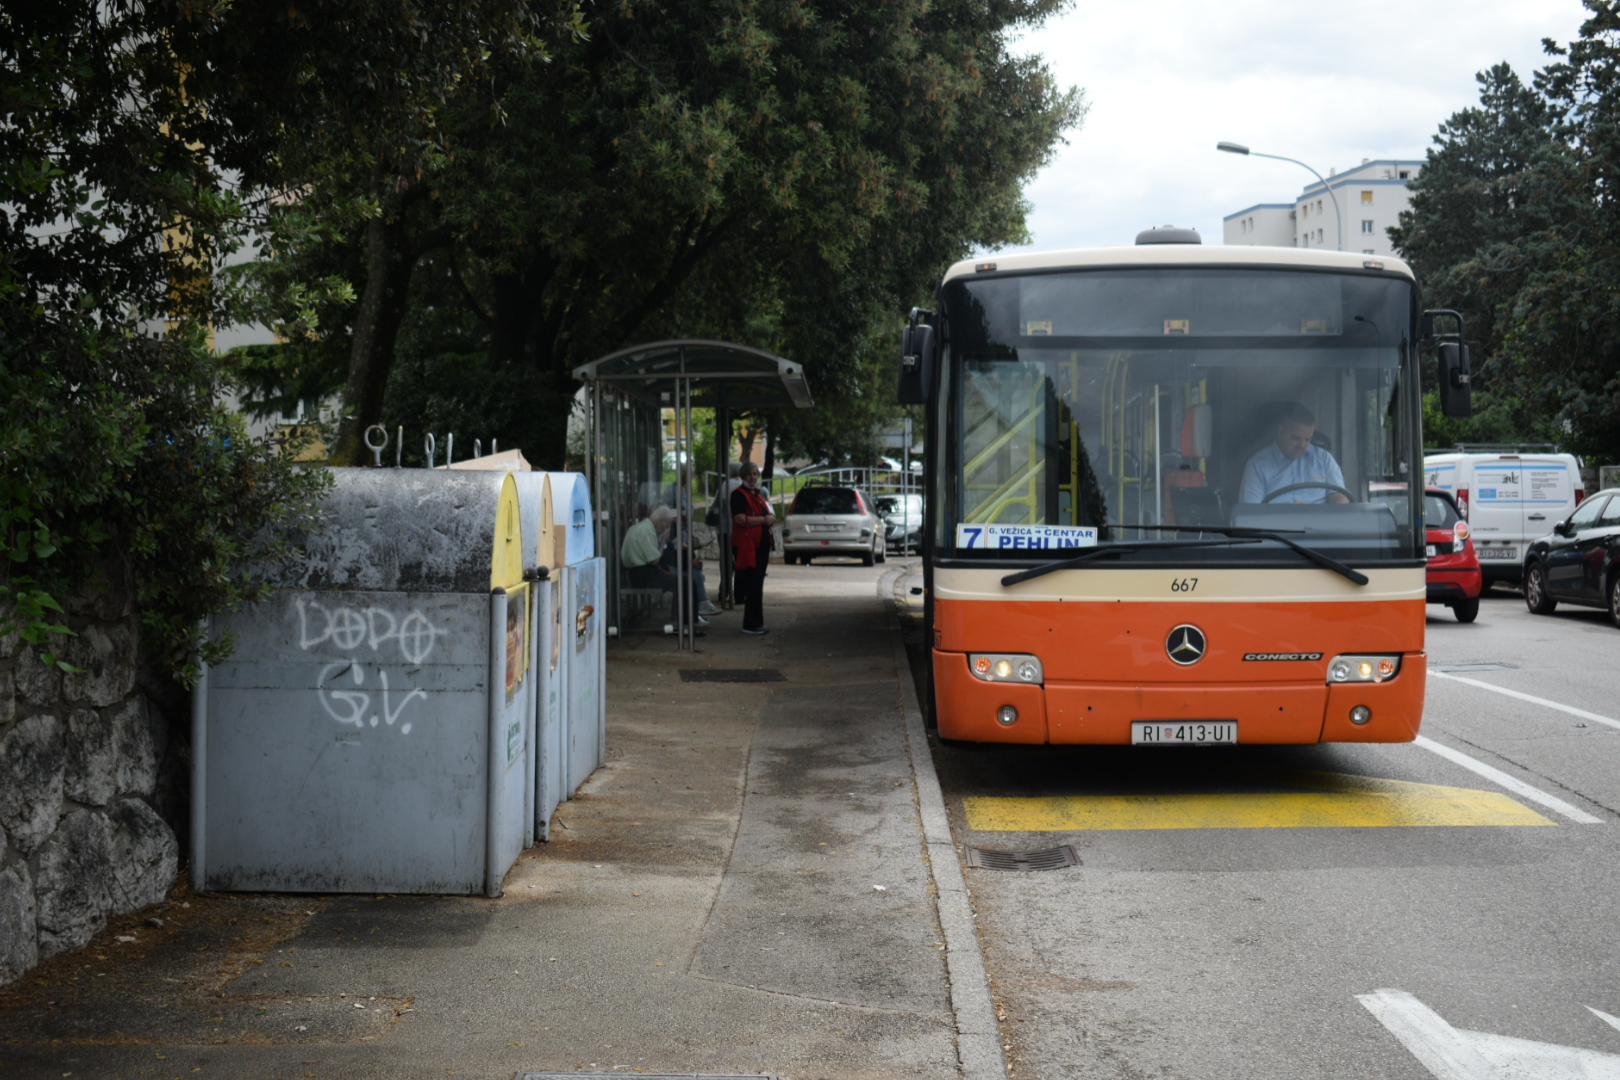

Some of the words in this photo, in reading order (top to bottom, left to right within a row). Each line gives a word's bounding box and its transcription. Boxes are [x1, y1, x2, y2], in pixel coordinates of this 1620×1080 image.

[963, 528, 982, 549] 7
[989, 527, 998, 535] G.
[1000, 526, 1032, 536] VEŽICA
[1044, 528, 1093, 538] CENTAR
[1171, 578, 1198, 592] 667
[1244, 653, 1320, 661] CONECTO
[1143, 725, 1160, 742] RI
[1175, 724, 1231, 742] 413-UI
